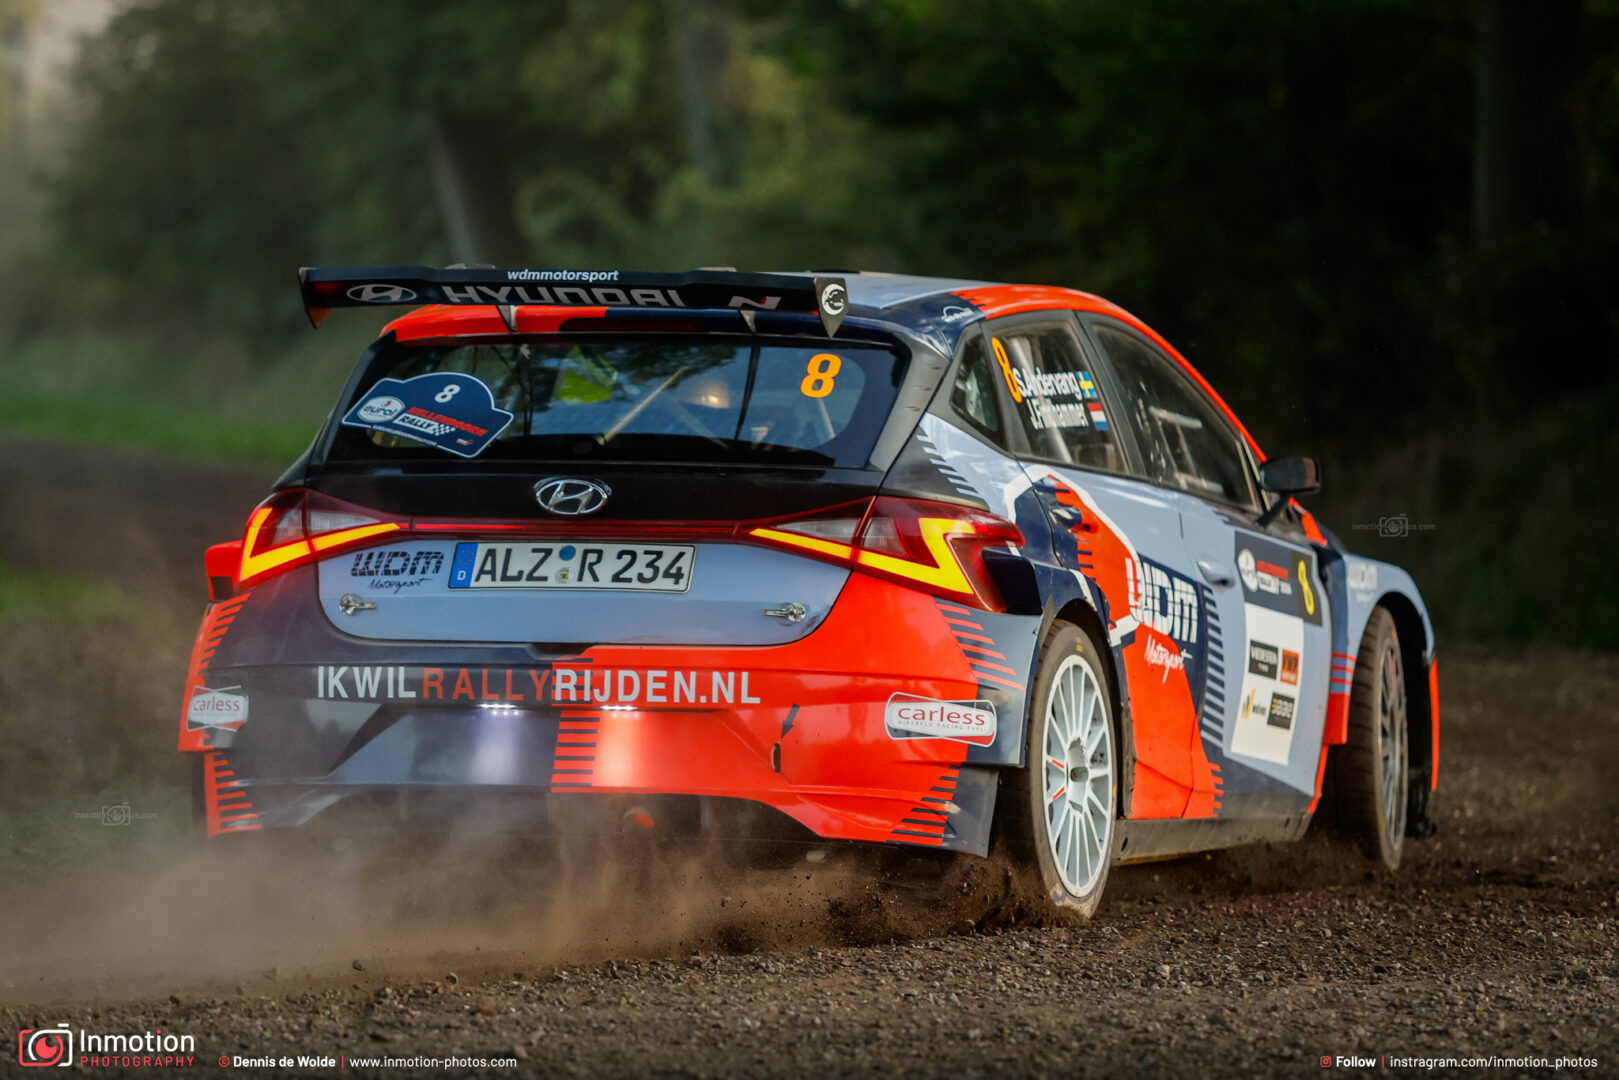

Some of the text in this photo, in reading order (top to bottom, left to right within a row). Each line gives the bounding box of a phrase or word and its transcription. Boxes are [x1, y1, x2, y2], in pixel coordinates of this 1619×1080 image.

[507, 269, 619, 283] wdmmotorsport
[441, 285, 687, 307] HYUNDAI
[800, 353, 842, 398] 8
[991, 337, 1023, 403] 8
[433, 384, 461, 403] 8
[363, 405, 398, 416] eurol
[399, 415, 434, 430] RALLY
[457, 548, 687, 585] D ALZ R 234
[317, 665, 761, 704] IKWILRALLYRIJDEN.NL
[193, 696, 241, 712] carless
[897, 706, 985, 726] carless
